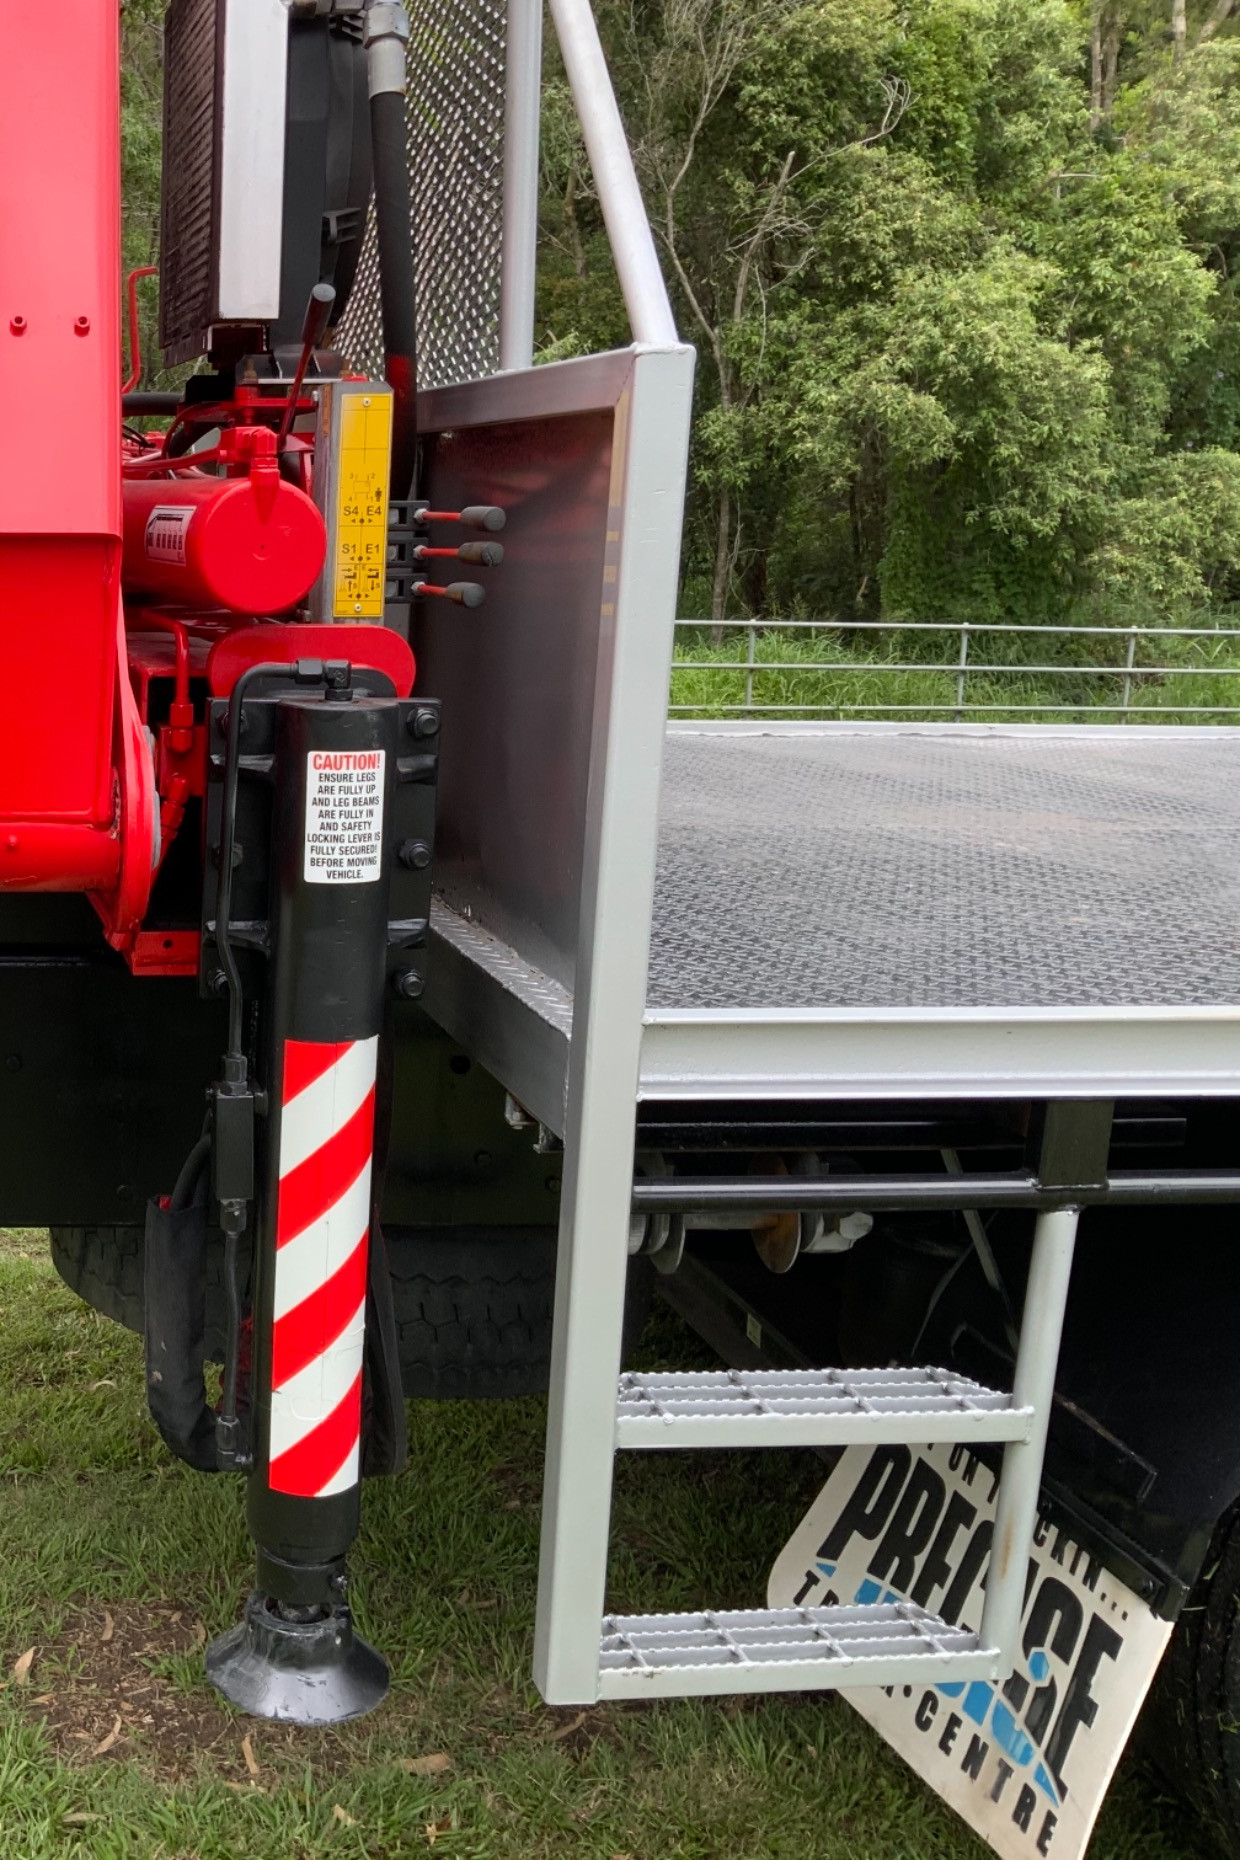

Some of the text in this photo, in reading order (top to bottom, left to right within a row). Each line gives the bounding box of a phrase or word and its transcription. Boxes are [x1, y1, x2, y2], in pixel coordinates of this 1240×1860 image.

[343, 505, 382, 516] S4 E4
[342, 543, 380, 554] S1 E1
[313, 753, 381, 771] CAUTION!
[318, 772, 376, 783] ENSURE LEGS
[317, 784, 376, 795] ARE FULLY UP
[311, 796, 380, 807] AND LEG BEAMS
[318, 809, 374, 819] ARE FULLY IN
[319, 821, 372, 831] AND SAFETY
[307, 831, 381, 843] LOCKING LEVER IS
[310, 845, 336, 855] FULLY
[310, 856, 377, 867] BEFORE MOVING
[326, 869, 364, 880] VEHICLE.
